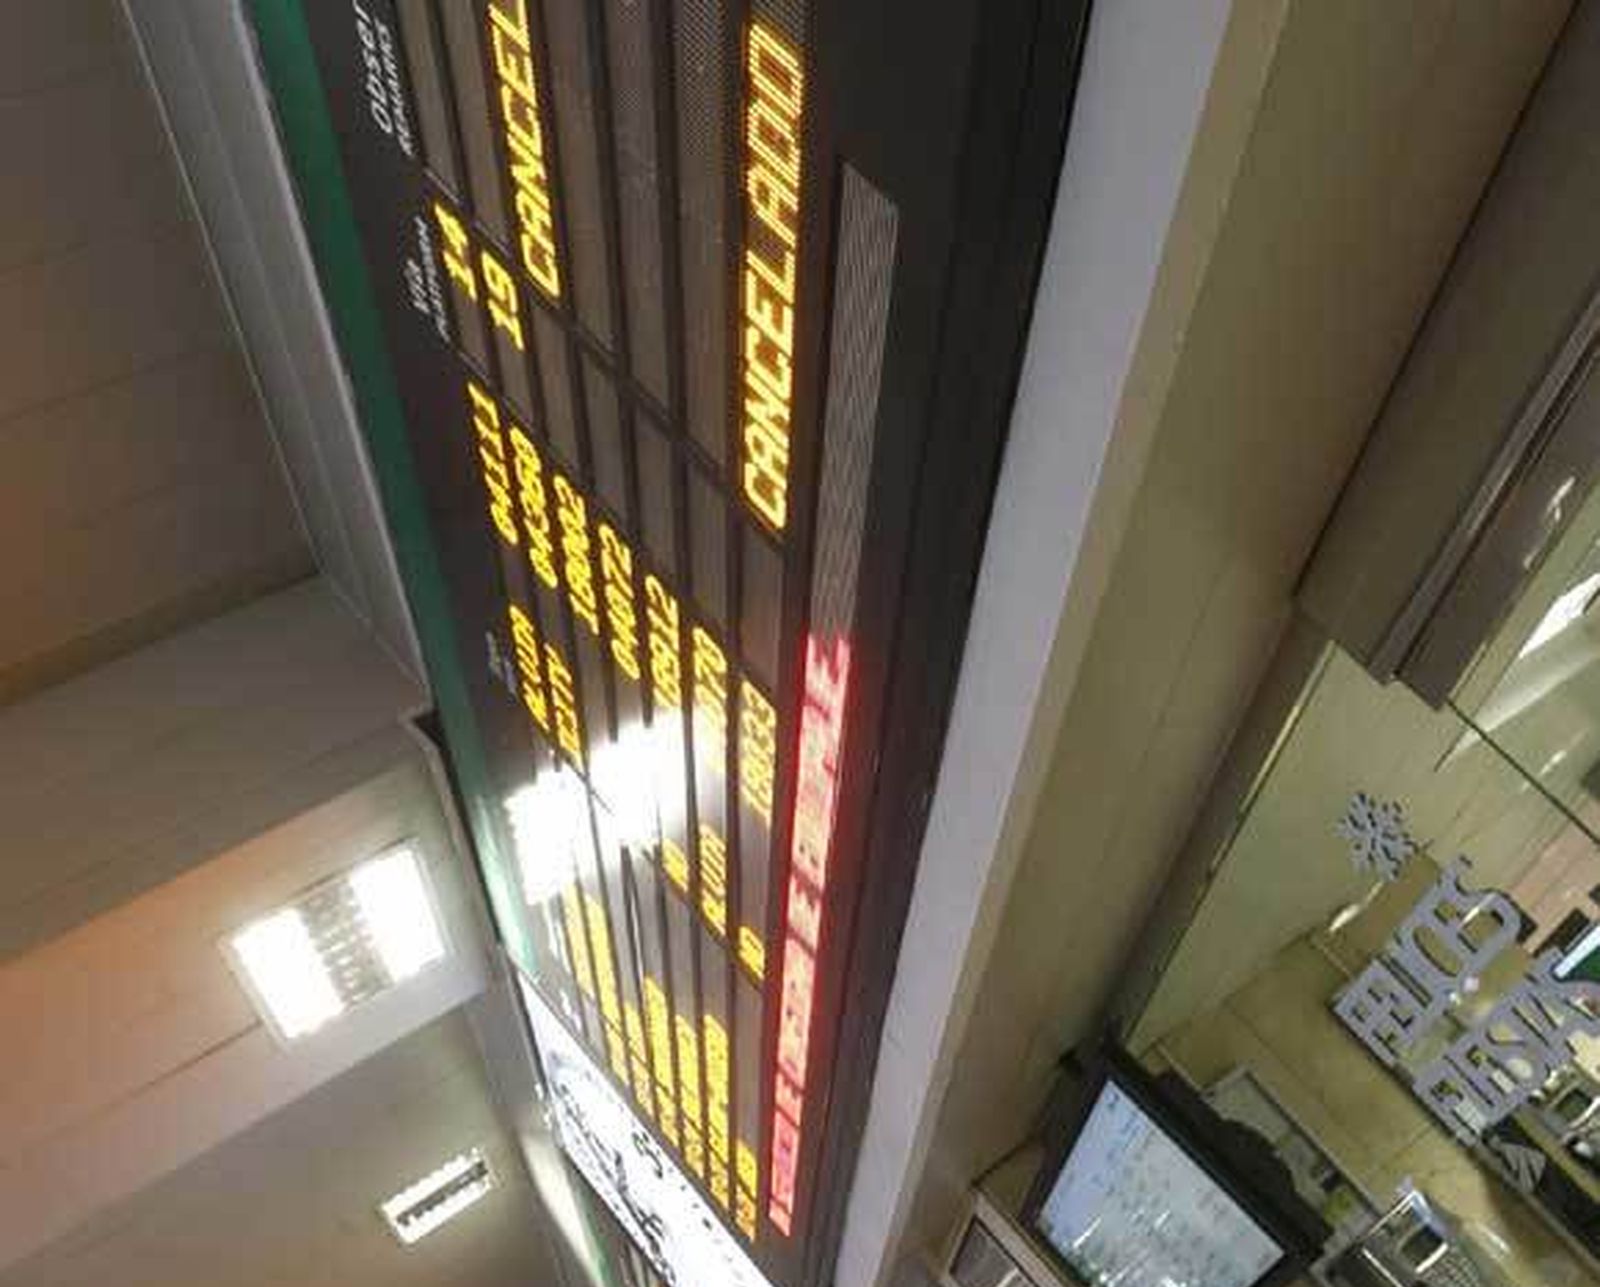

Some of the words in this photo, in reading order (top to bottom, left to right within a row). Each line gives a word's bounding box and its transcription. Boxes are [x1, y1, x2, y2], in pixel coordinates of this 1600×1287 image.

[435, 203, 477, 301] 14
[481, 251, 524, 350] 19
[744, 22, 804, 530] CANCELADO
[468, 382, 518, 545] 04111
[553, 475, 600, 635] 18002
[598, 524, 641, 681] 04072
[1332, 860, 1522, 1062] FELICES
